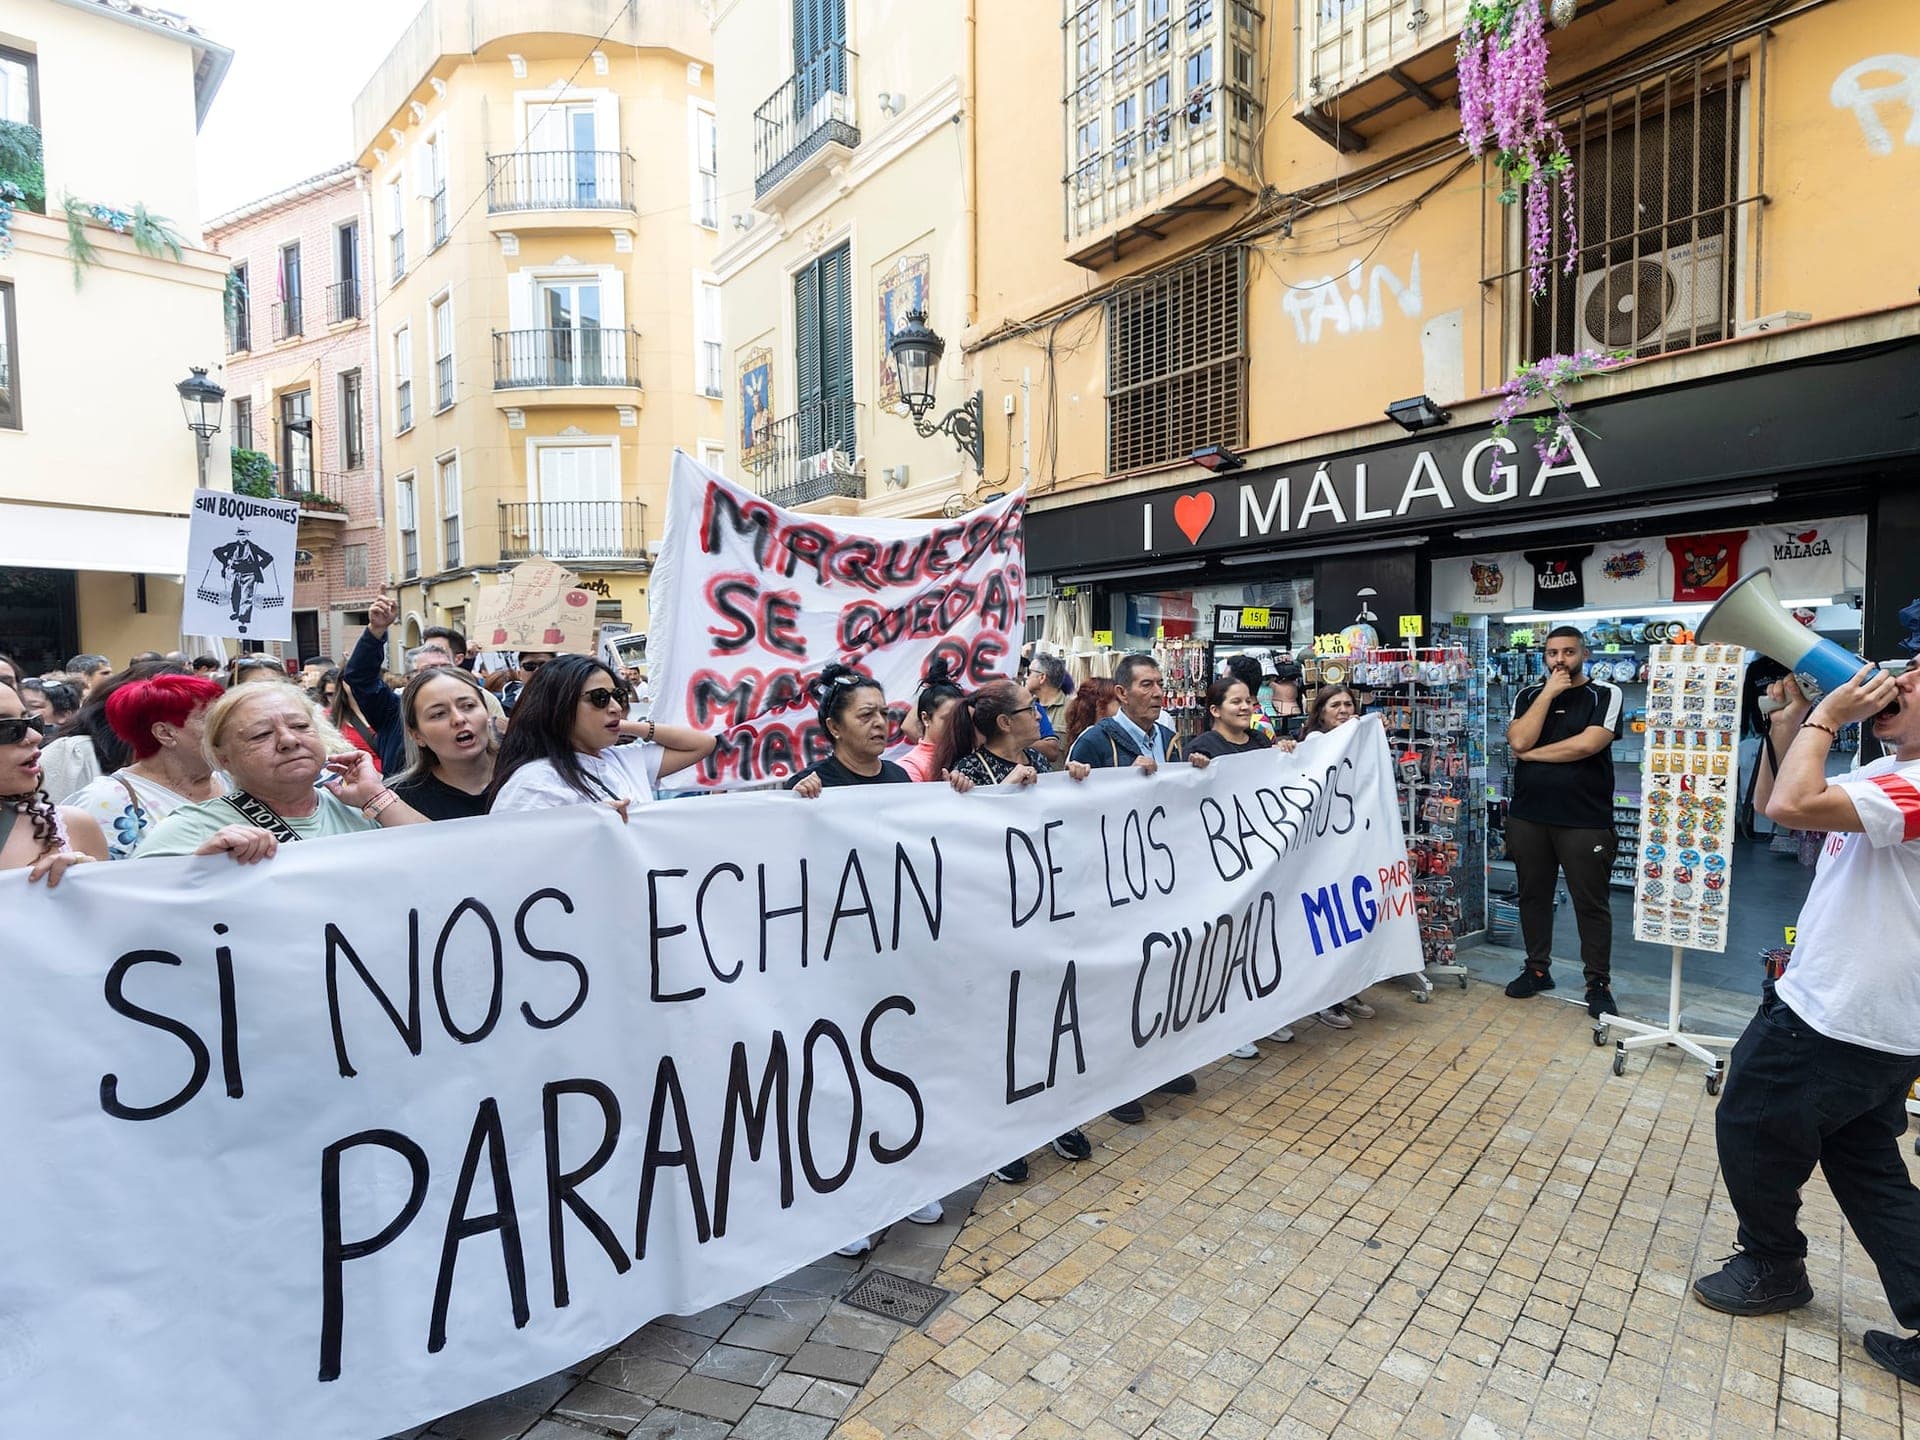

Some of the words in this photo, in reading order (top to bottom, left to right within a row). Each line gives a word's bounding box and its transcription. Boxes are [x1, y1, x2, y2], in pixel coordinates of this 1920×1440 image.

[1671, 240, 1717, 261] SAMUNG
[195, 497, 216, 514] SIN
[219, 497, 298, 524] BOQUERONES
[1143, 503, 1153, 550] I
[1239, 424, 1601, 538] MÁLAGA
[704, 572, 808, 664] SE
[242, 798, 282, 830] LOLA
[325, 887, 589, 1078] NOS
[648, 836, 942, 1002] ECHAN
[1006, 820, 1076, 928] DE
[1101, 805, 1175, 907] LOS
[1301, 875, 1377, 956] MLG
[1379, 861, 1411, 895] PAR
[318, 995, 924, 1382] PARAMOS
[1006, 960, 1086, 1105] LA
[1131, 891, 1282, 1048] CIUDAD
